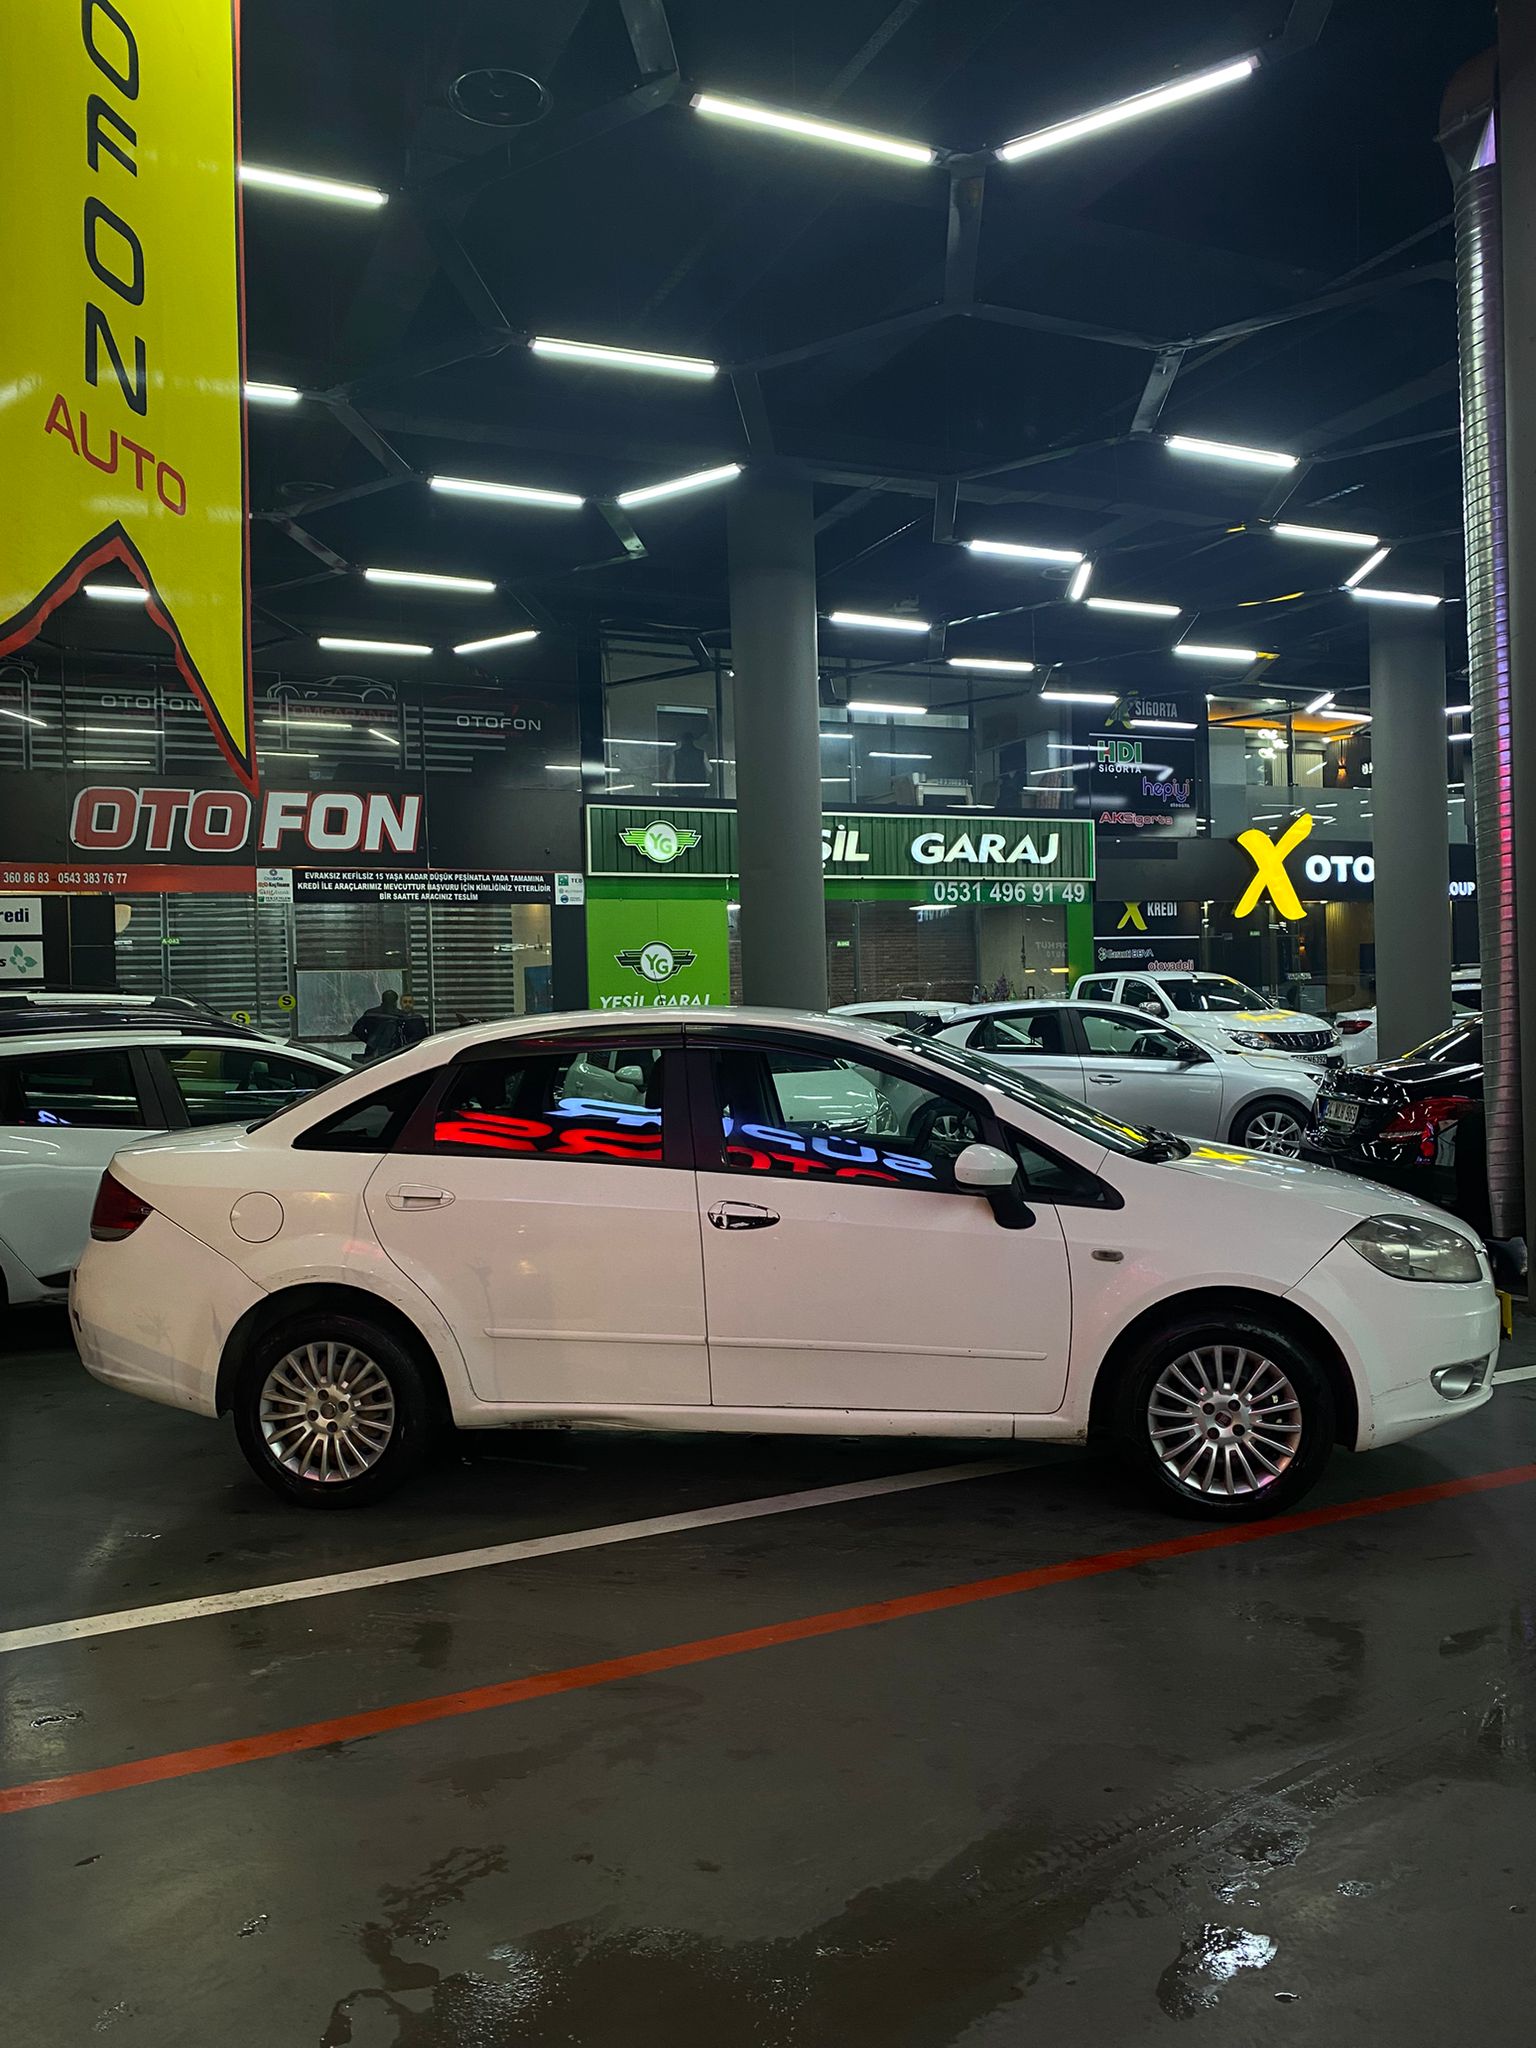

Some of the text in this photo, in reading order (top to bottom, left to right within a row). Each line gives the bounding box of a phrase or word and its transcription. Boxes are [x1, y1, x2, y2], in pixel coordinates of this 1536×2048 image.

[44, 393, 187, 516] AUTO
[456, 715, 542, 731] OTOFON
[1097, 740, 1142, 763] HDI
[649, 832, 672, 854] YG
[910, 832, 1059, 865] GARAJ
[3, 872, 128, 884] 360 86 83 0543 383 76 77
[375, 872, 384, 880] 15
[1305, 854, 1375, 883] OTO
[933, 881, 1086, 903] 0531 496 91 49
[1449, 881, 1476, 896] OUP
[645, 953, 669, 974] YG
